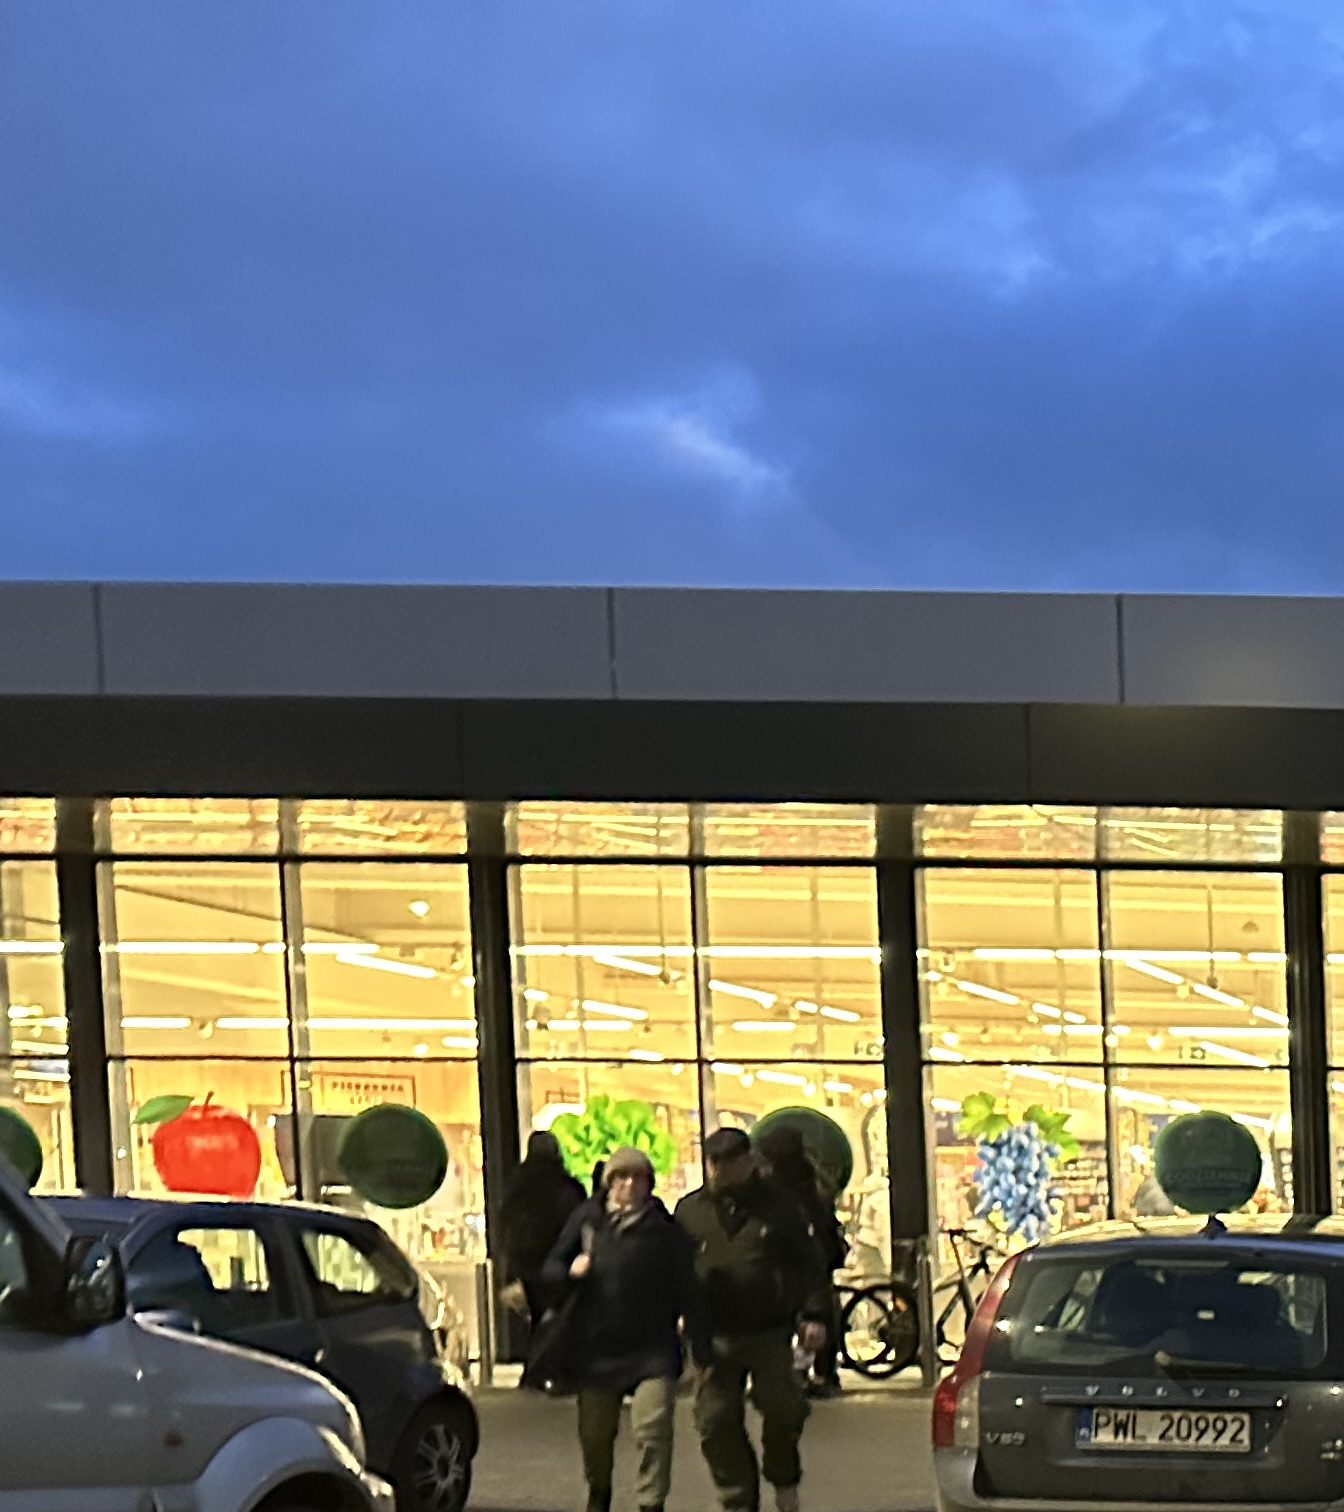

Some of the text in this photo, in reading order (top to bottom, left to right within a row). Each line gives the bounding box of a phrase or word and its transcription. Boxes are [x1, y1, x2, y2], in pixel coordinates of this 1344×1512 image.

[1085, 1384, 1241, 1398] VOLVO
[1094, 1411, 1246, 1445] PWL 20992
